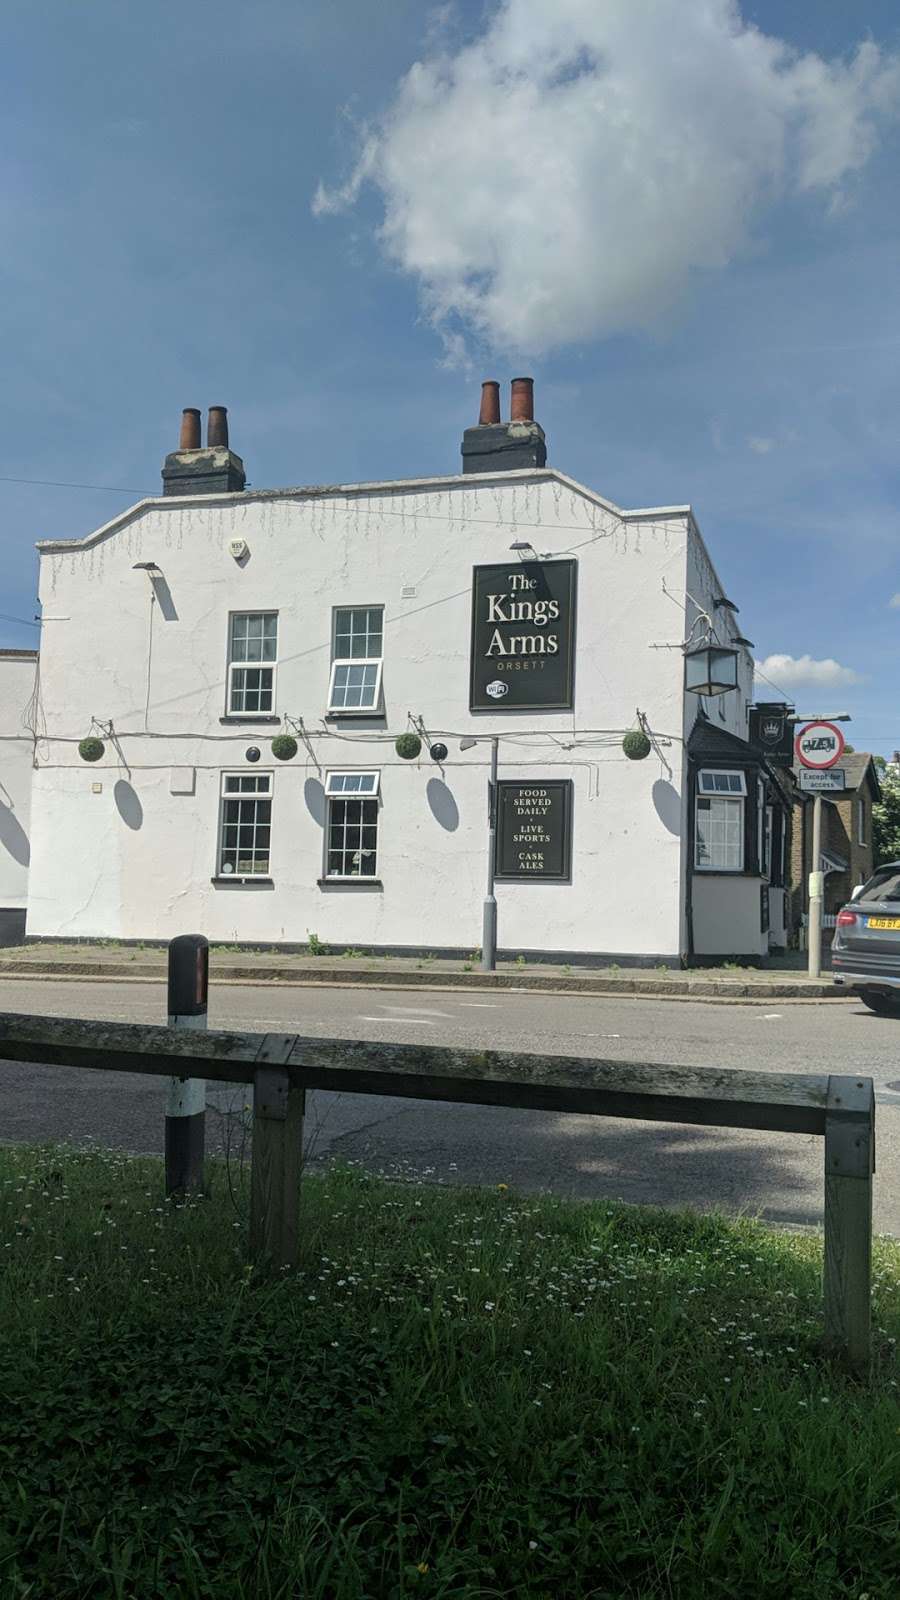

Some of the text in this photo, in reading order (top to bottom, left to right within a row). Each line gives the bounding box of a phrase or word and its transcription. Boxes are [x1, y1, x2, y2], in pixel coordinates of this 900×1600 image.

[508, 575, 537, 590] The
[486, 593, 559, 626] Kings
[485, 629, 558, 656] Arms
[497, 661, 545, 671] ORSETT
[803, 773, 828, 781] Except
[519, 789, 547, 797] FOOD
[513, 798, 552, 806] SERVED
[520, 825, 544, 833] LIVE
[513, 834, 551, 842] SPORTS
[518, 852, 545, 860] CASK
[519, 861, 544, 870] ALES
